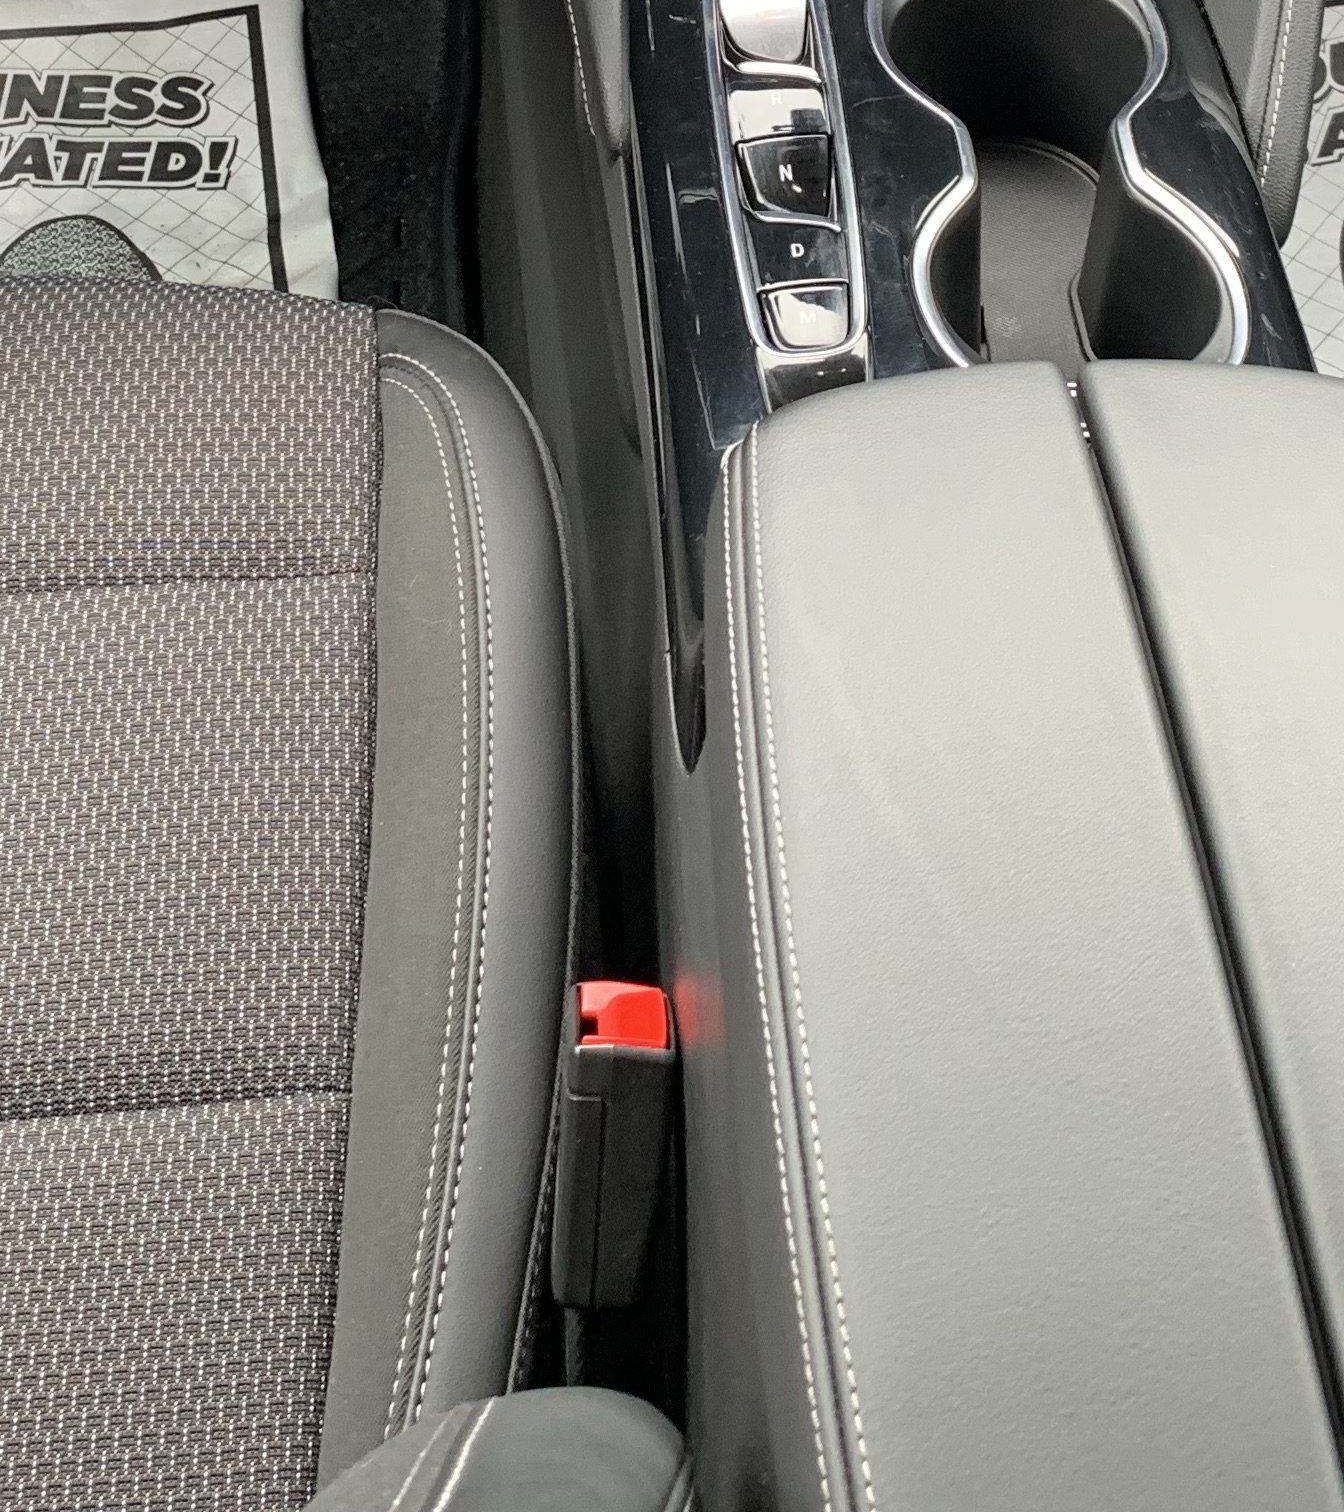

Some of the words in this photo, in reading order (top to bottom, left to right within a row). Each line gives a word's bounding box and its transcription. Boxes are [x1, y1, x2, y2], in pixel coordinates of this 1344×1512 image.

[771, 93, 783, 105] R
[778, 164, 794, 182] N
[790, 243, 805, 258] D
[799, 310, 817, 325] M
